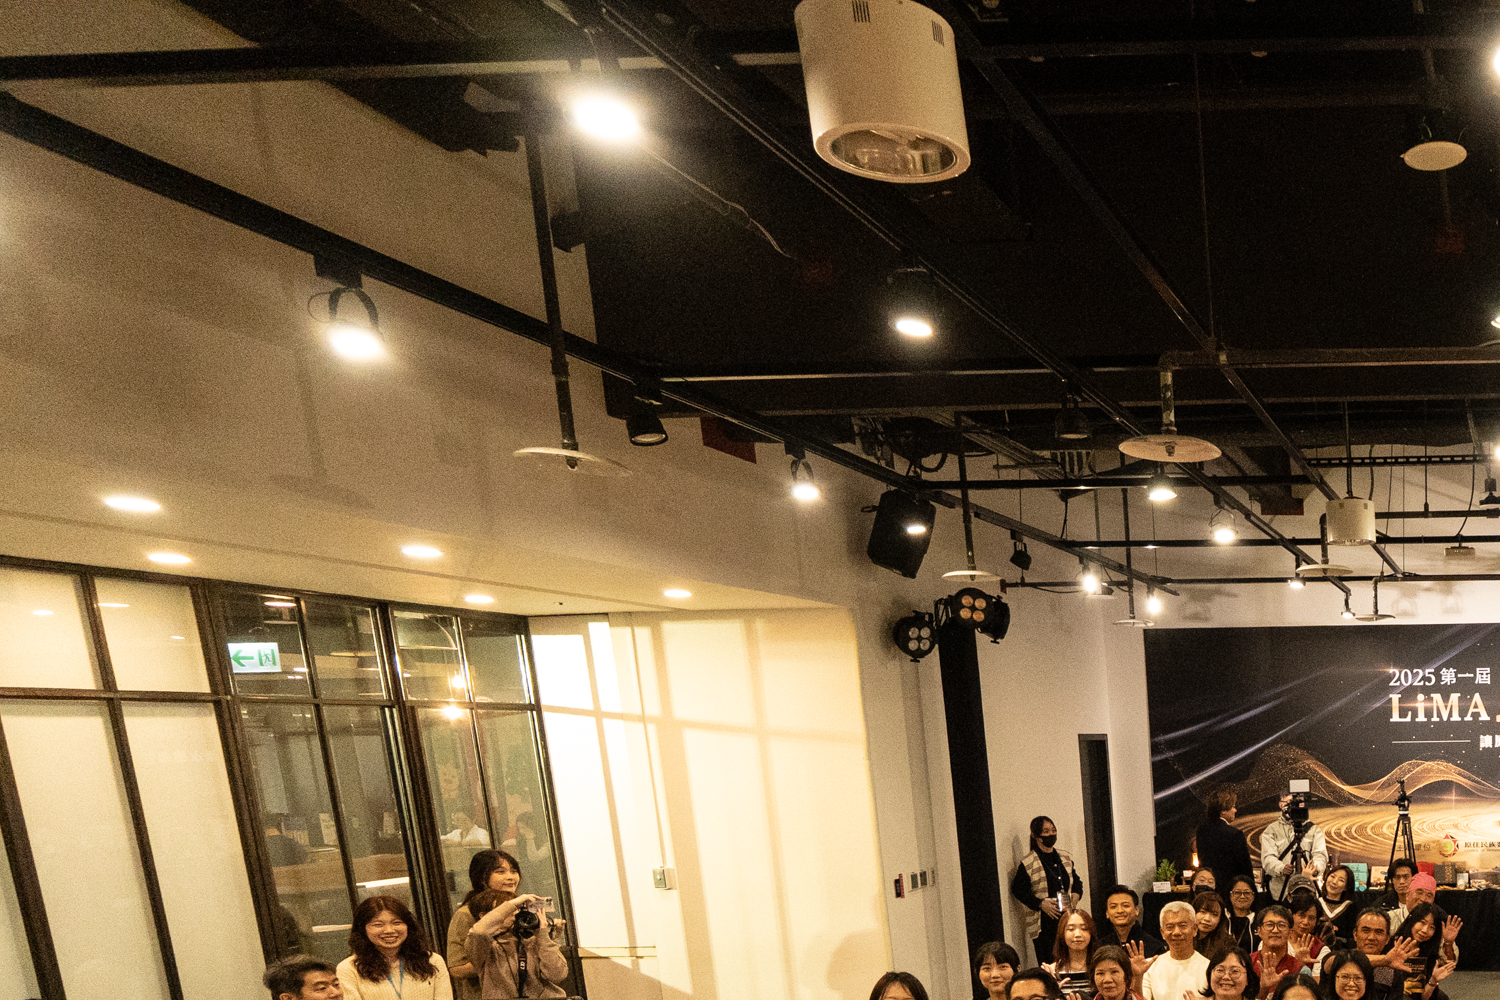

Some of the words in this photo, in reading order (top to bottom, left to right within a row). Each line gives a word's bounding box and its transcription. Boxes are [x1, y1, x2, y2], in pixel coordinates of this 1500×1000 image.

[1389, 668, 1436, 686] 2025
[1440, 667, 1491, 685] 第一屆
[1389, 693, 1490, 722] LiMA
